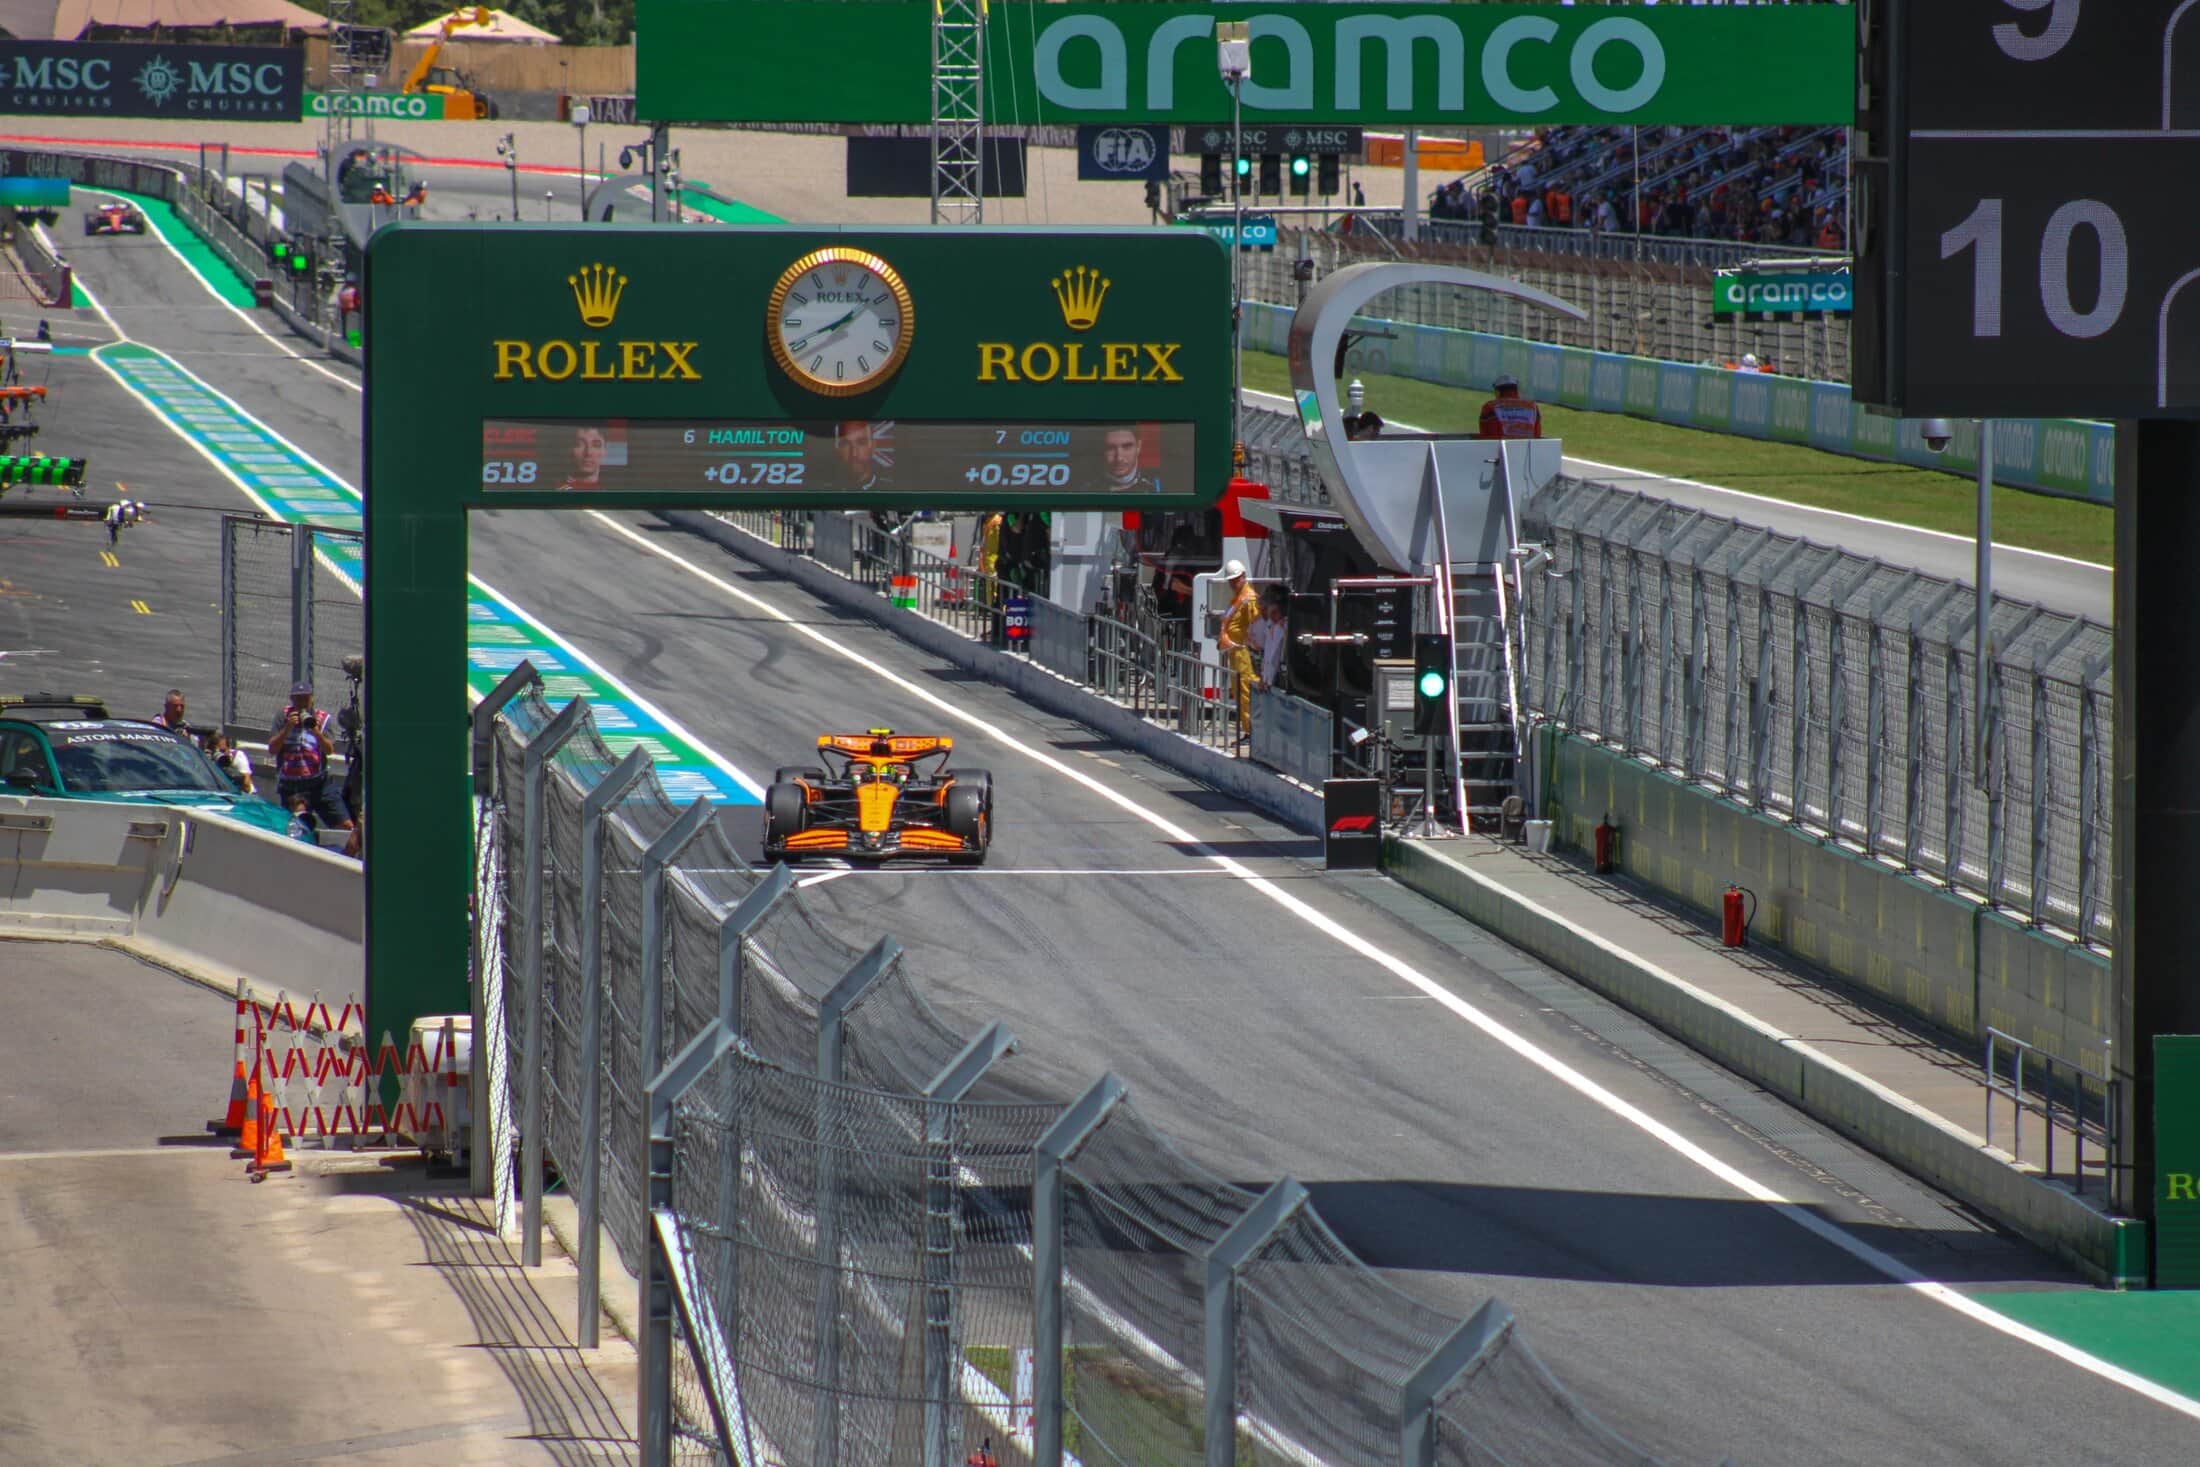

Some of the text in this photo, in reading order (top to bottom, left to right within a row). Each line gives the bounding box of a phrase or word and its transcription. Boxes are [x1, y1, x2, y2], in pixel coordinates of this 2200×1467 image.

[14, 57, 111, 90] MSC
[1034, 13, 1666, 113] aramco
[188, 62, 284, 94] MSC
[312, 95, 427, 116] aramco
[1224, 131, 1267, 145] MSC
[1306, 131, 1348, 145] MSC
[1940, 198, 2128, 338] 10
[816, 291, 864, 303] ROLEX
[1727, 283, 1847, 304] aramco
[493, 339, 702, 379] ROLEX
[976, 342, 1184, 382] ROLEX
[684, 429, 804, 445] 6 HAMILTON
[995, 431, 1070, 445] 7 OCON
[482, 461, 538, 483] 618
[704, 463, 805, 485] +0.782
[965, 463, 1070, 486] +0.920
[67, 734, 177, 744] ASTON MARTIN
[2166, 1173, 2200, 1200] R
